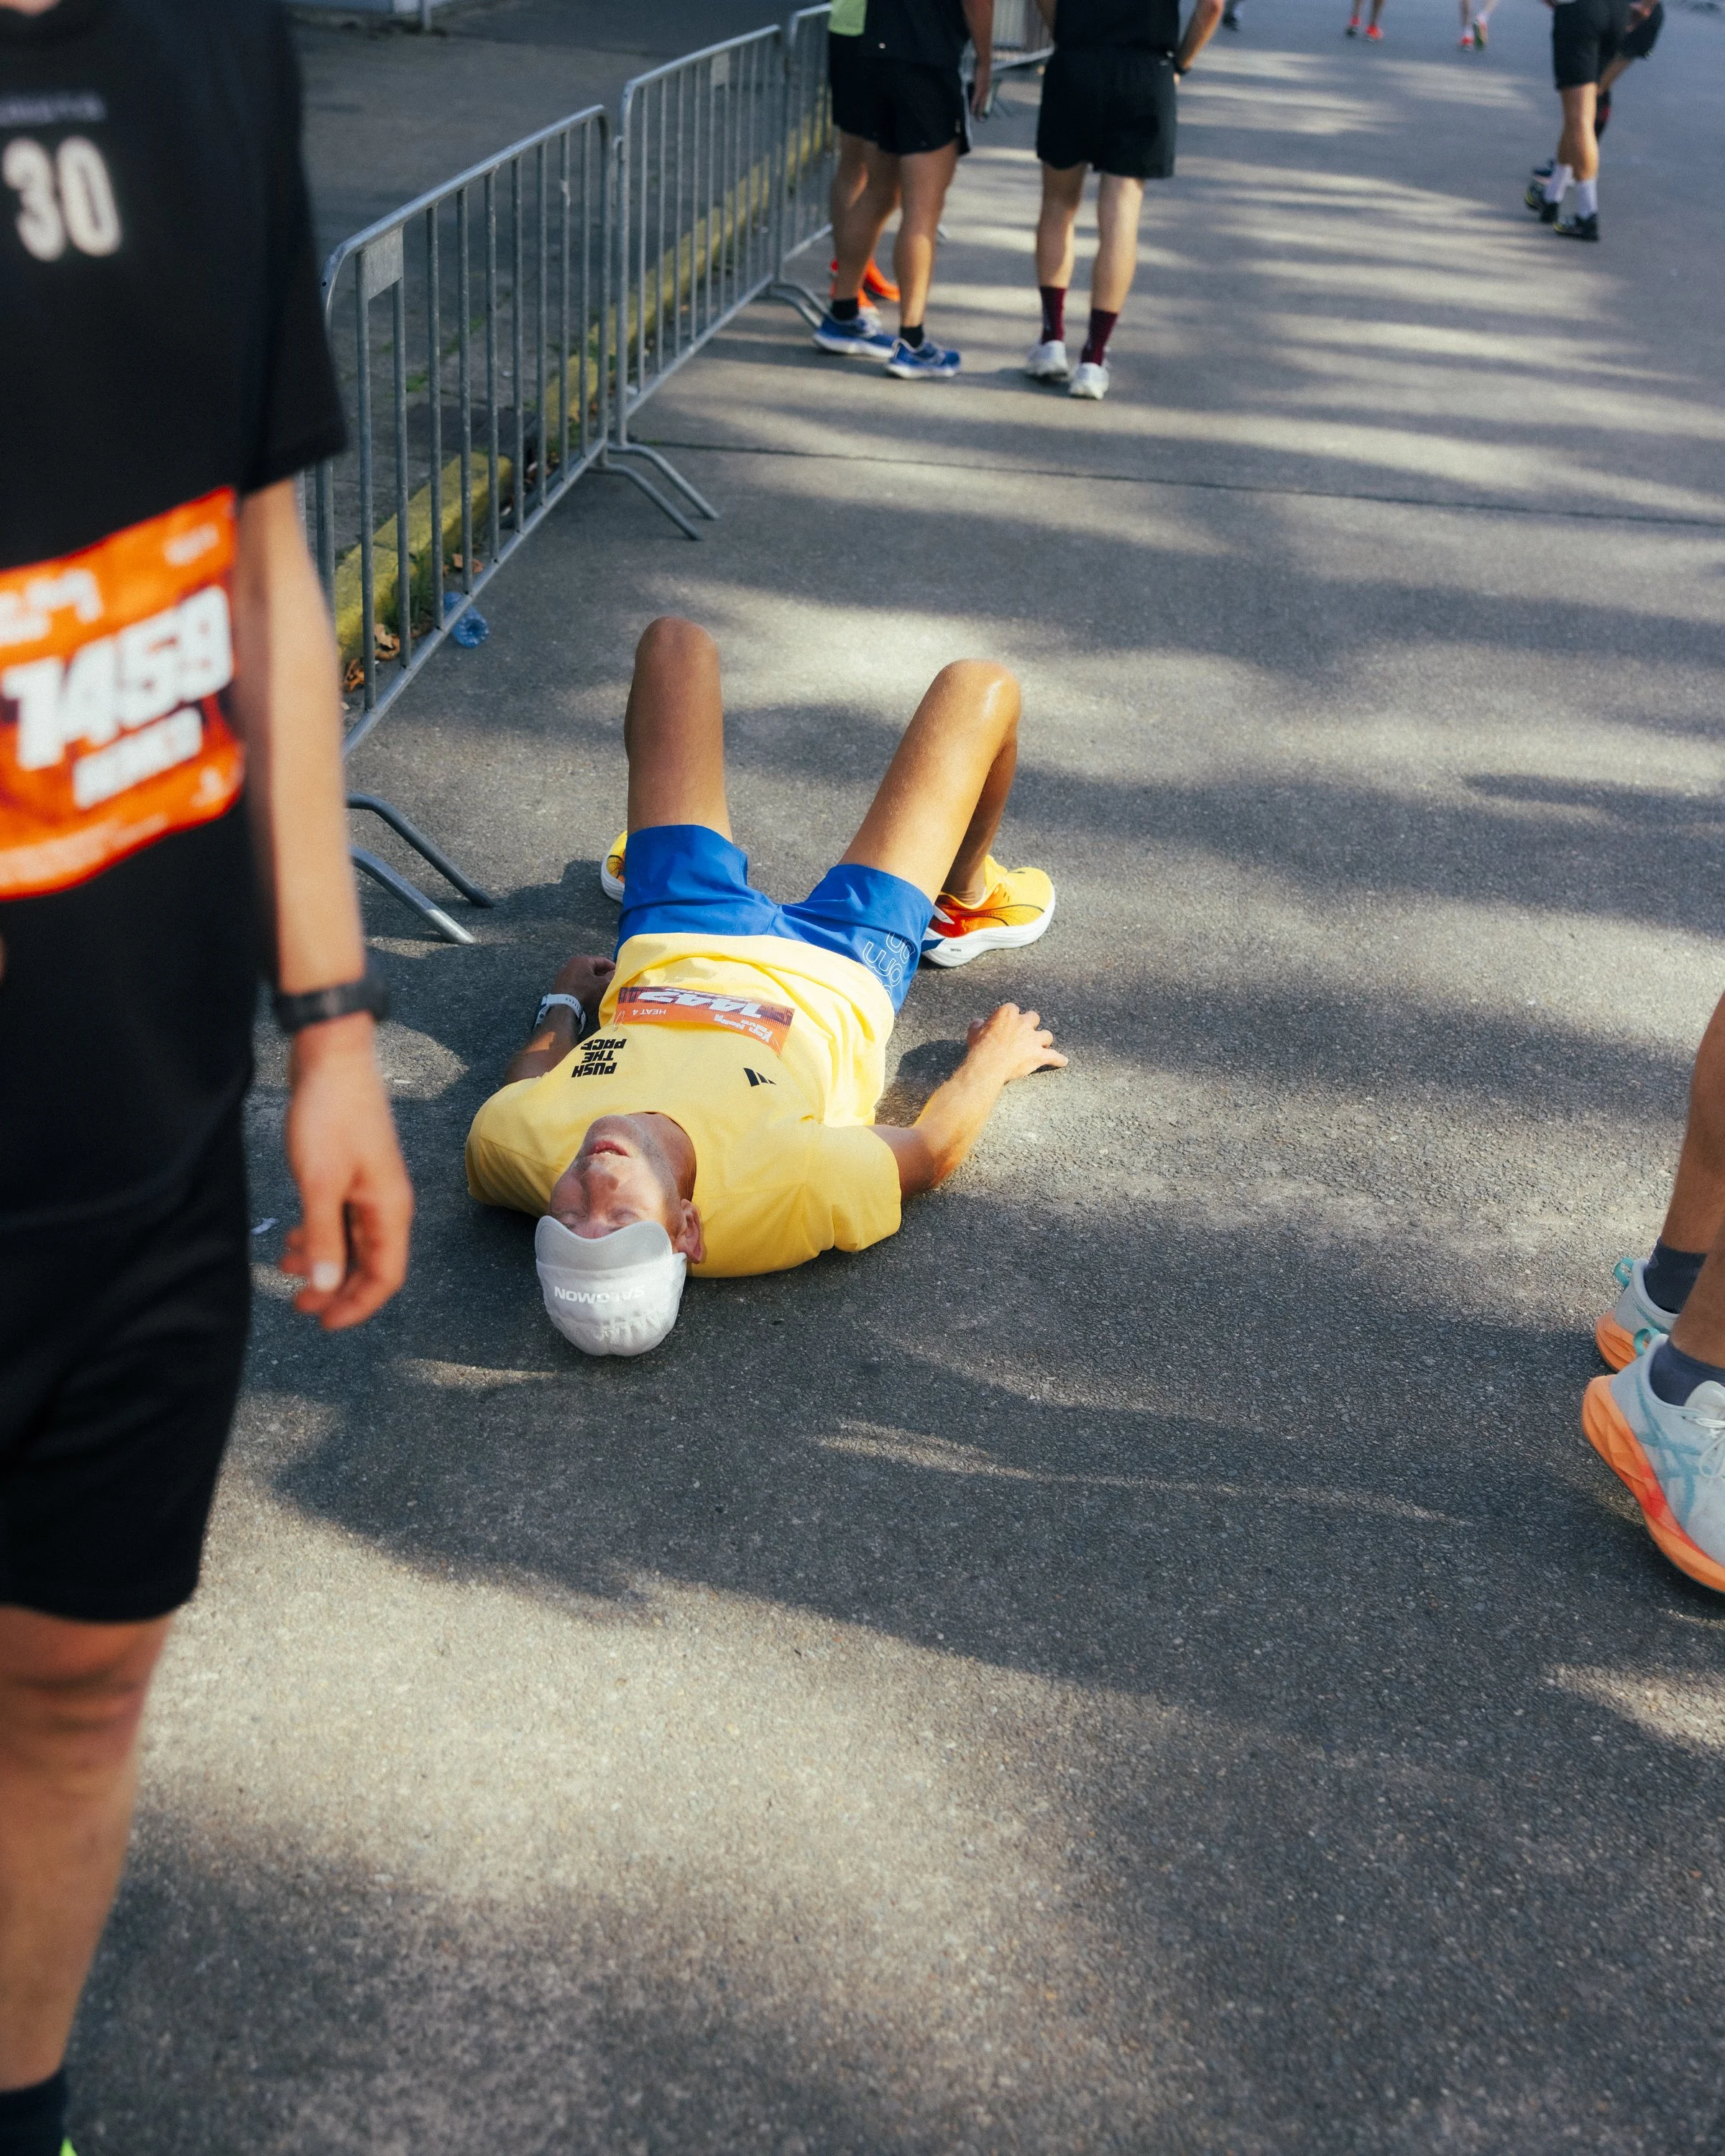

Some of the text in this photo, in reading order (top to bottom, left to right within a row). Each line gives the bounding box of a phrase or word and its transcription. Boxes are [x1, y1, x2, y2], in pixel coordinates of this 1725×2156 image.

[3, 137, 121, 260] 30
[581, 1050, 614, 1064] THE
[571, 1062, 617, 1077] PUSH
